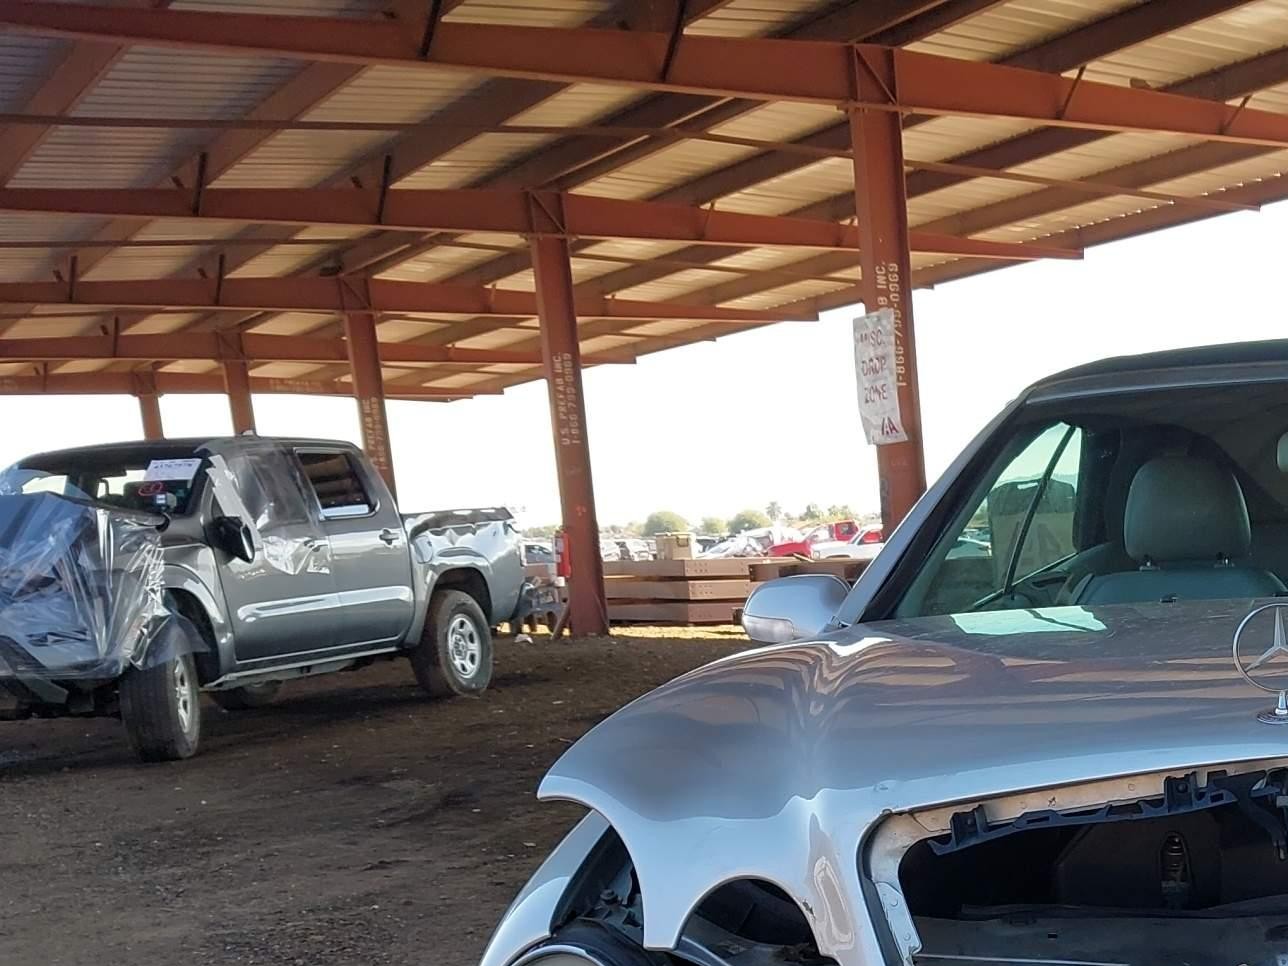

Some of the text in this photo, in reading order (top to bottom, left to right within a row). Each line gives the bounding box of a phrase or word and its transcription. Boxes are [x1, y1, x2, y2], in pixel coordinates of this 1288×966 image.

[875, 261, 887, 289] INC.
[861, 356, 887, 377] DROP
[864, 383, 888, 404] ZONE
